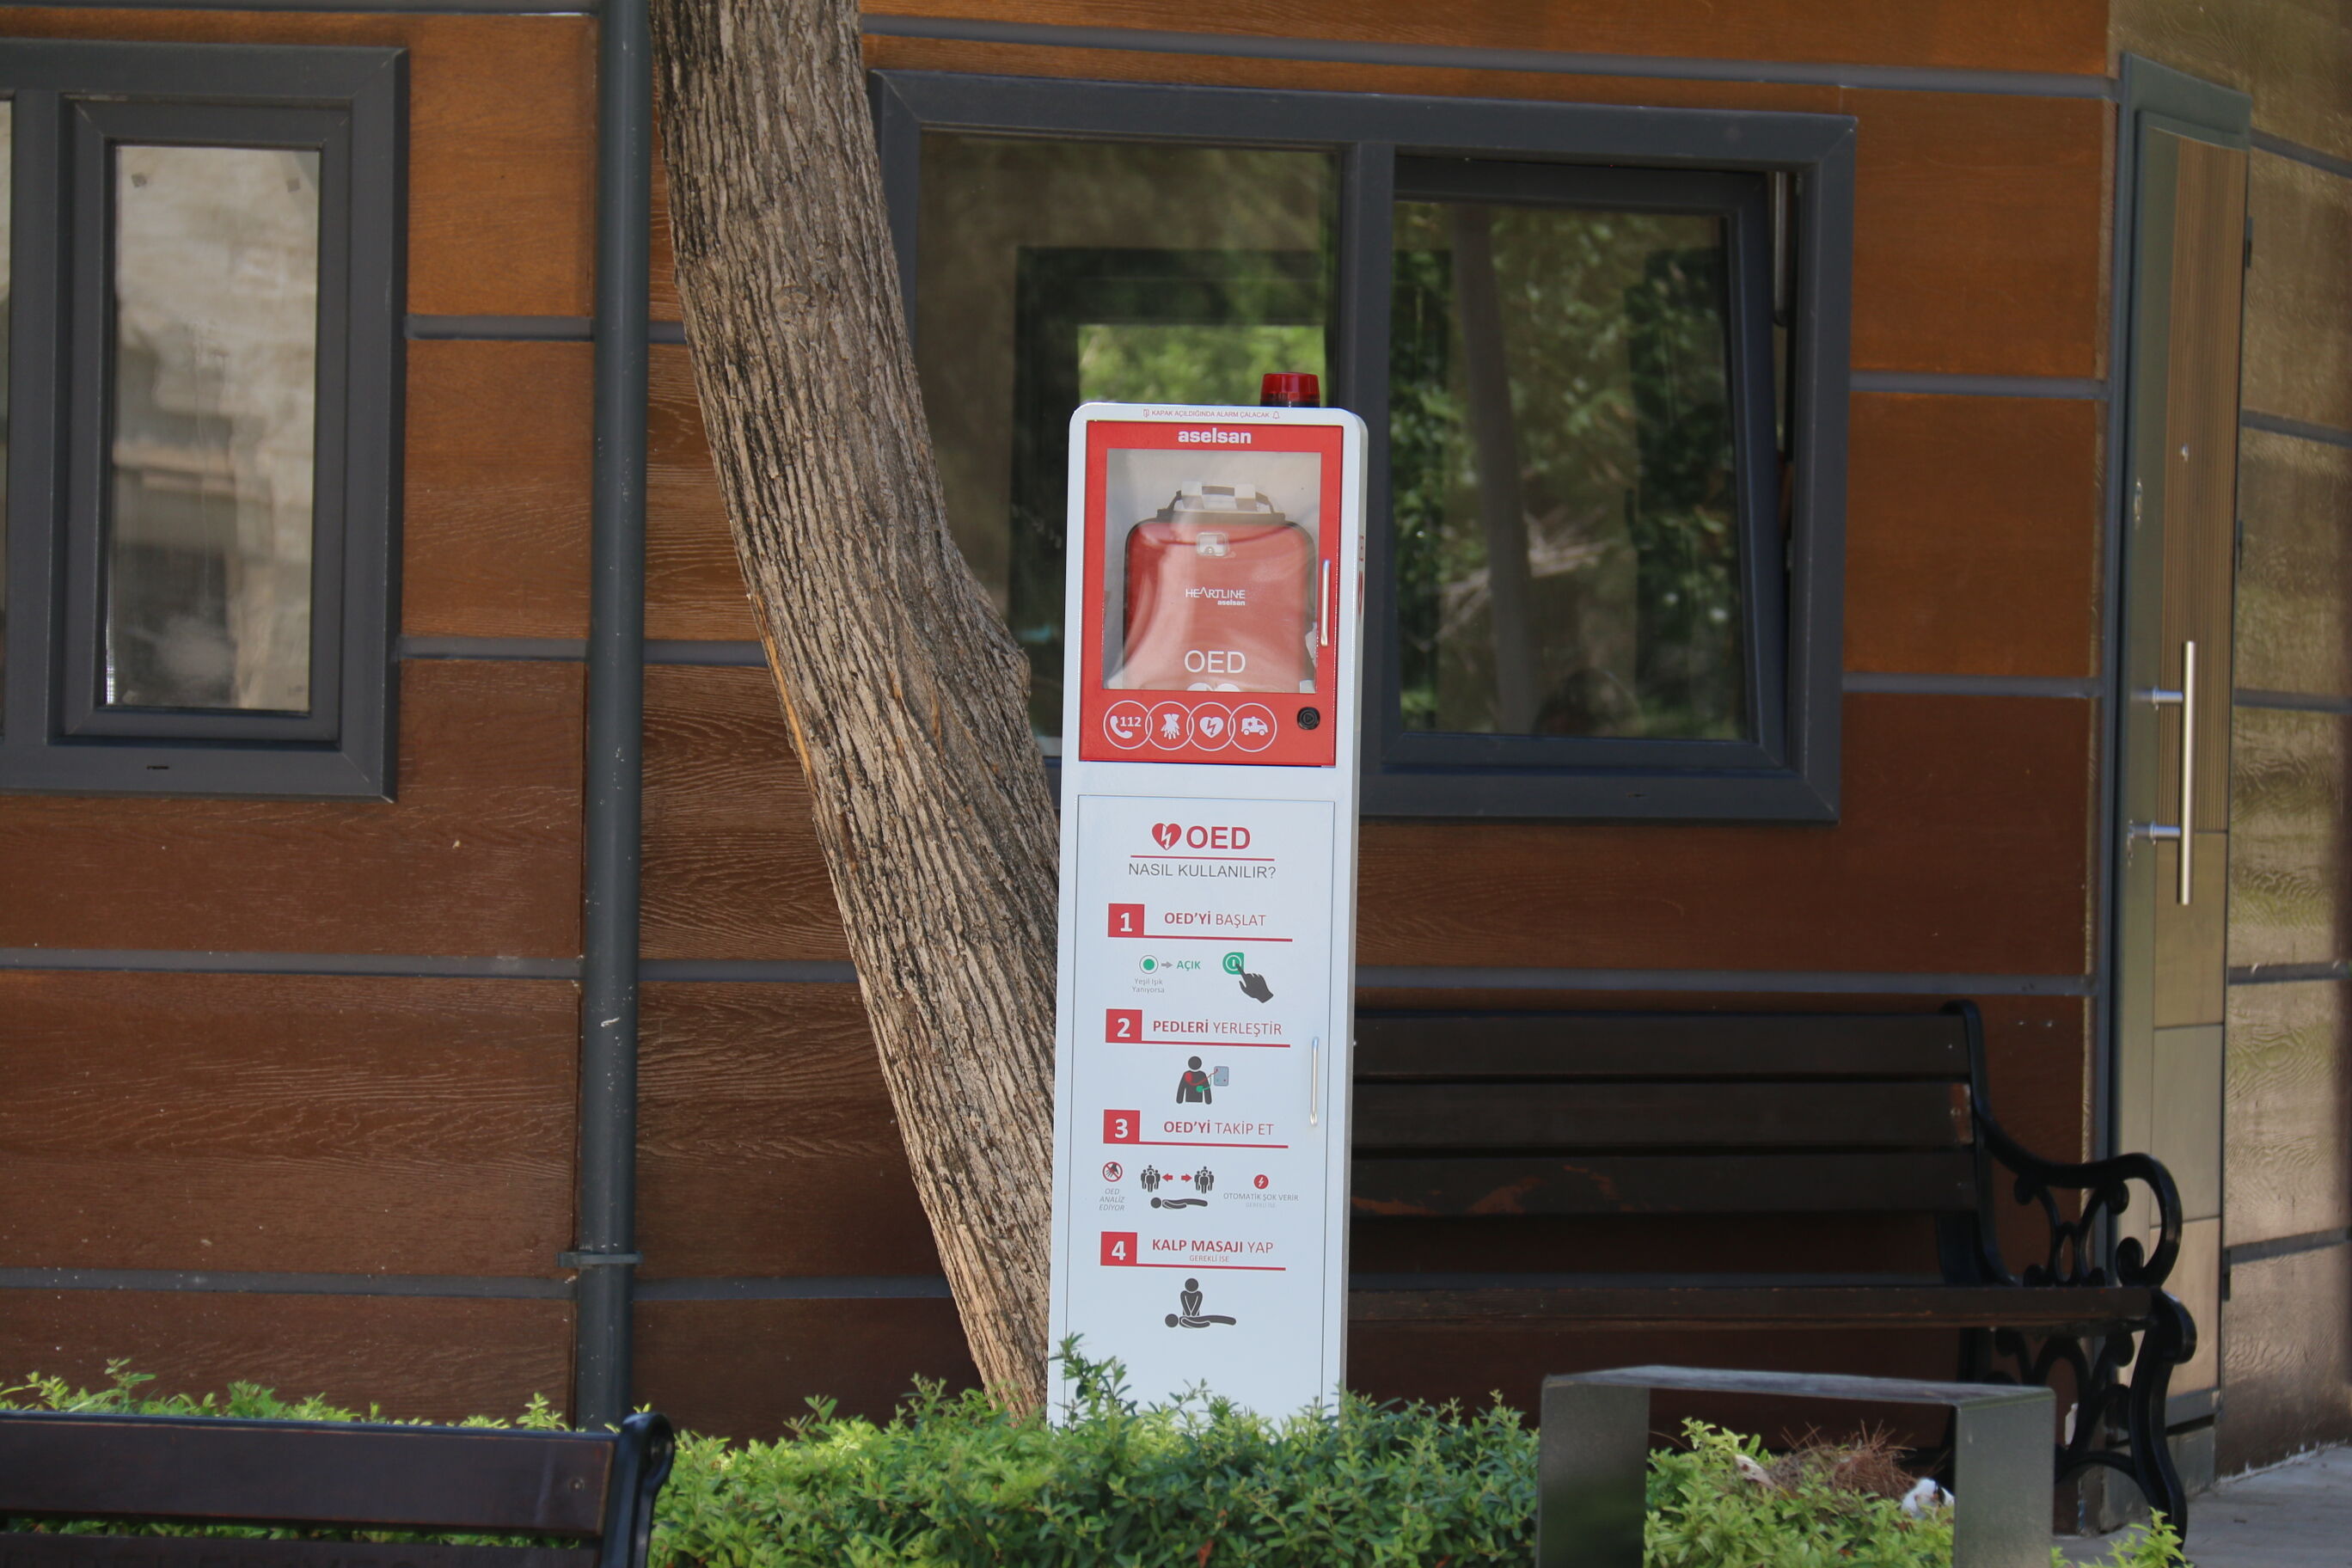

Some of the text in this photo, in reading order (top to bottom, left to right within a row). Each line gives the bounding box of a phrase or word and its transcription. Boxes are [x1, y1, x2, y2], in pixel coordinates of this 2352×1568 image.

[1178, 427, 1252, 444] aselsan
[1185, 586, 1246, 599] HEARTLINE
[1184, 650, 1246, 674] OED
[1119, 716, 1142, 728] 112
[1185, 825, 1251, 850] OED
[1128, 862, 1277, 879] NASIL KULLANILIR?
[1119, 911, 1133, 933] 1
[1216, 914, 1266, 928] BAŞLAT
[1176, 960, 1201, 971] AÇIK
[1134, 977, 1150, 986] Yeşil
[1117, 1017, 1130, 1038] 2
[1153, 1019, 1282, 1037] PEDLERİ YERLEŞTİR
[1114, 1118, 1129, 1138] 3
[1215, 1121, 1253, 1136] TAKİP
[1258, 1123, 1275, 1136] ET
[1223, 1191, 1299, 1202] OTOMATİK ŞOK VERİR
[1099, 1203, 1125, 1211] EDİYOR
[1111, 1240, 1126, 1261] 4
[1152, 1239, 1274, 1254] KALP MASAJI YAP
[1189, 1254, 1217, 1263] GEREKLİ
